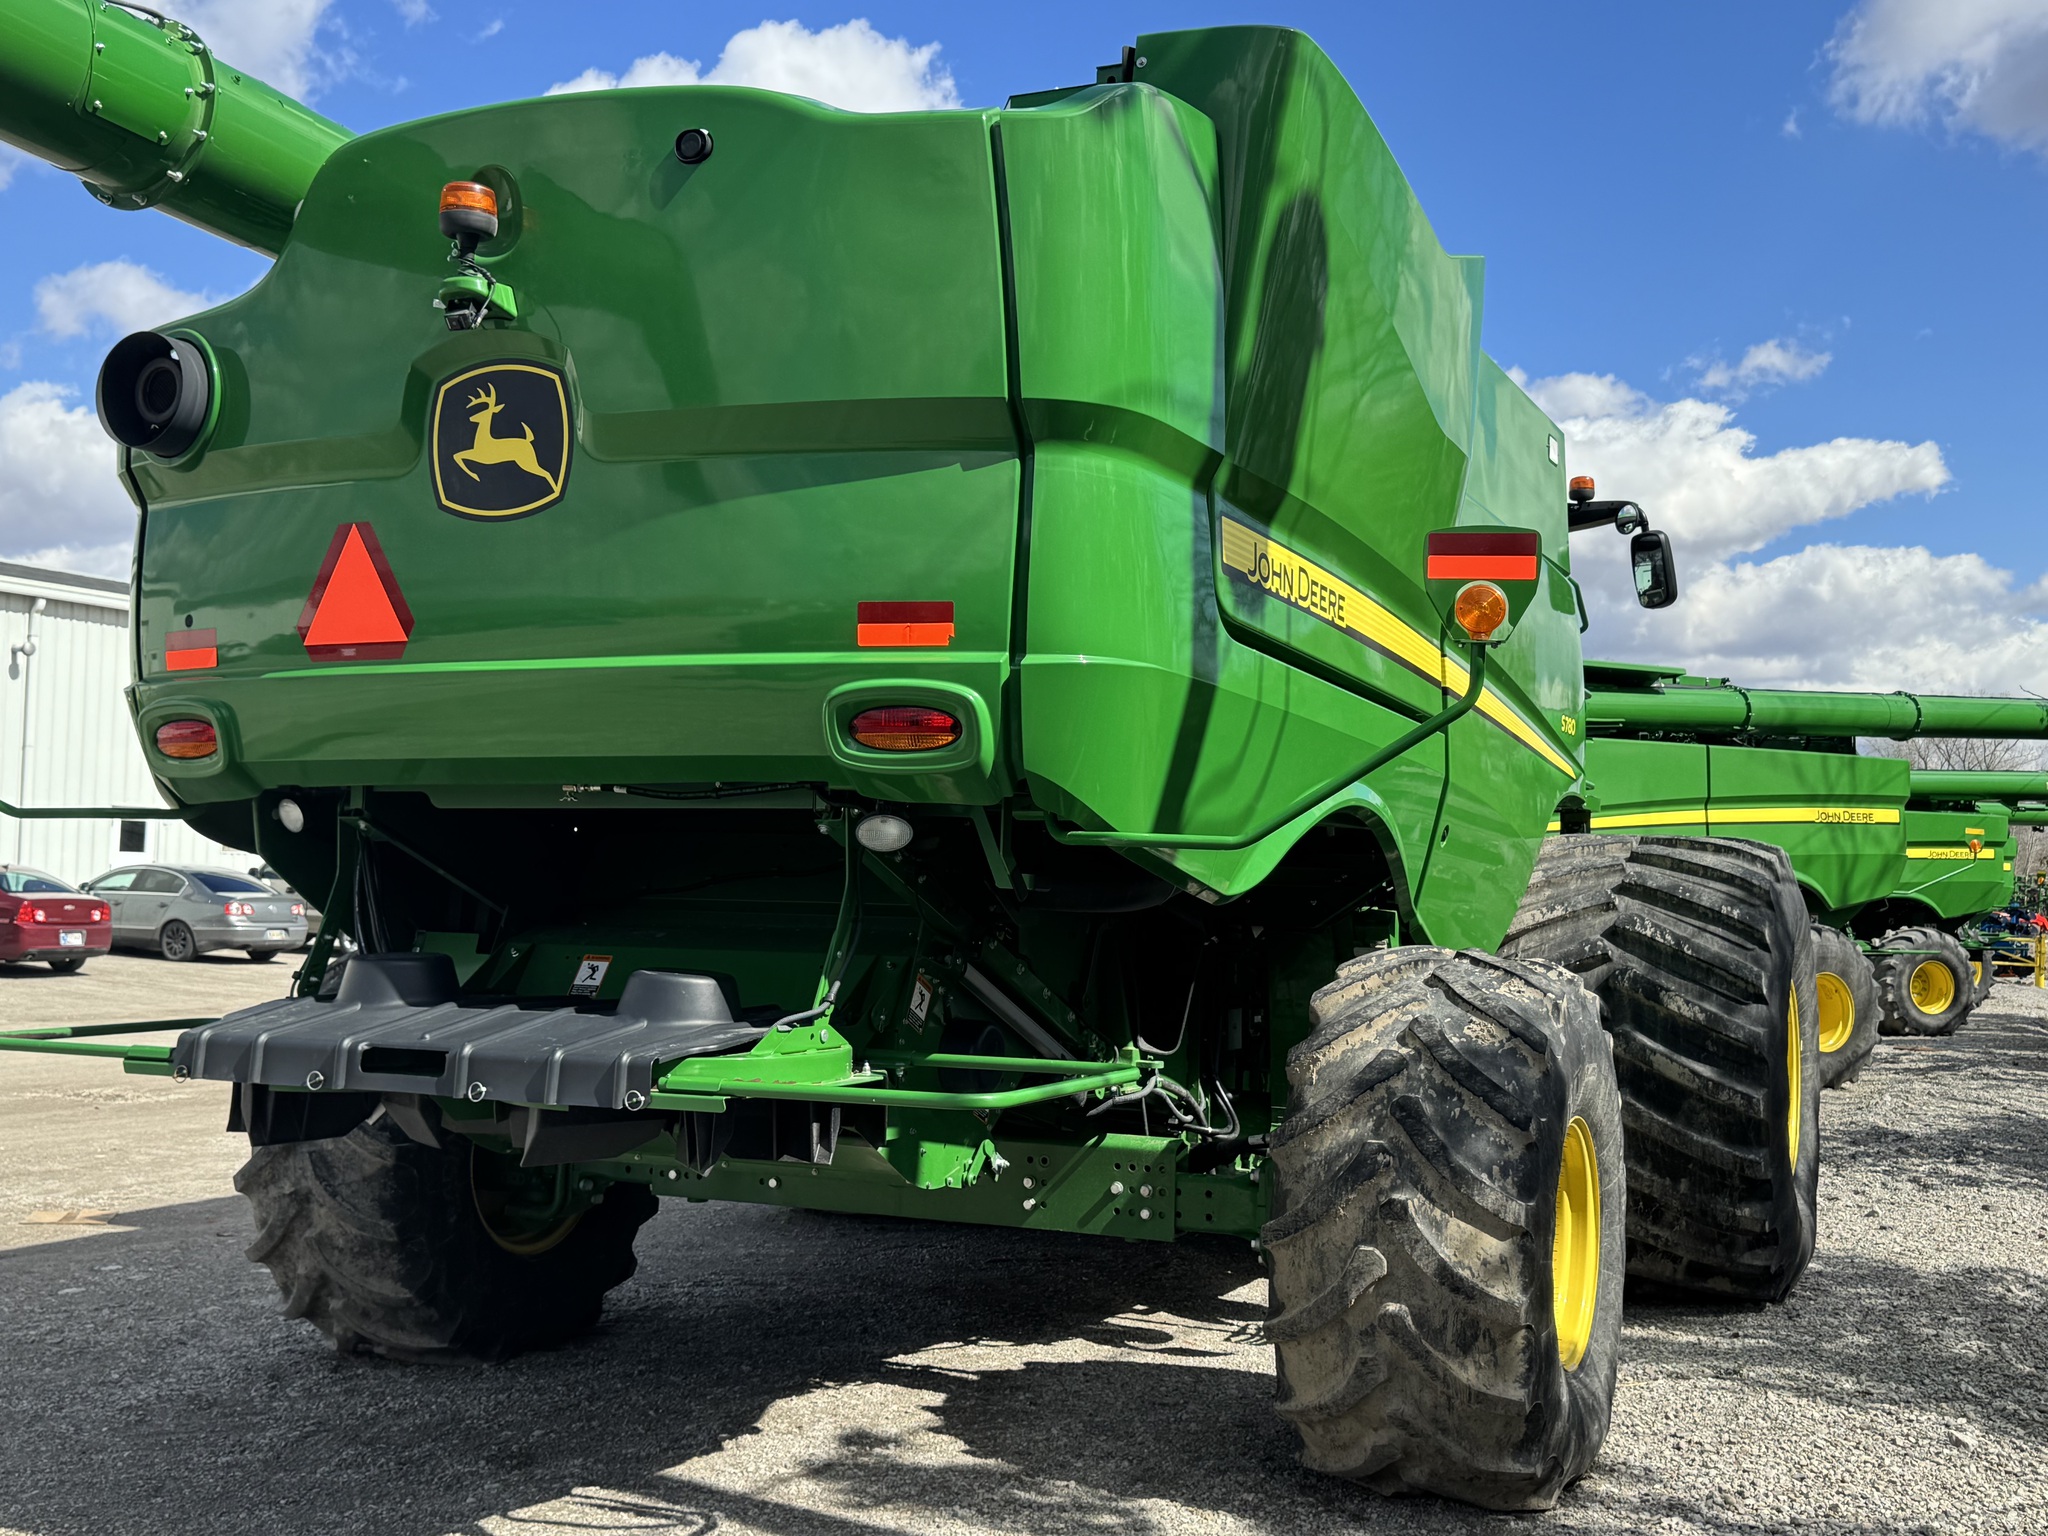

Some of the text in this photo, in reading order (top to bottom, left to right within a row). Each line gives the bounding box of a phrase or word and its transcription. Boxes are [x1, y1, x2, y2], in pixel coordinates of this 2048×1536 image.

[1247, 541, 1346, 623] JOHN DEERE
[1561, 714, 1576, 736] S780
[1815, 810, 1874, 821] JOHN DEERE
[1928, 850, 1948, 858] JOHN
